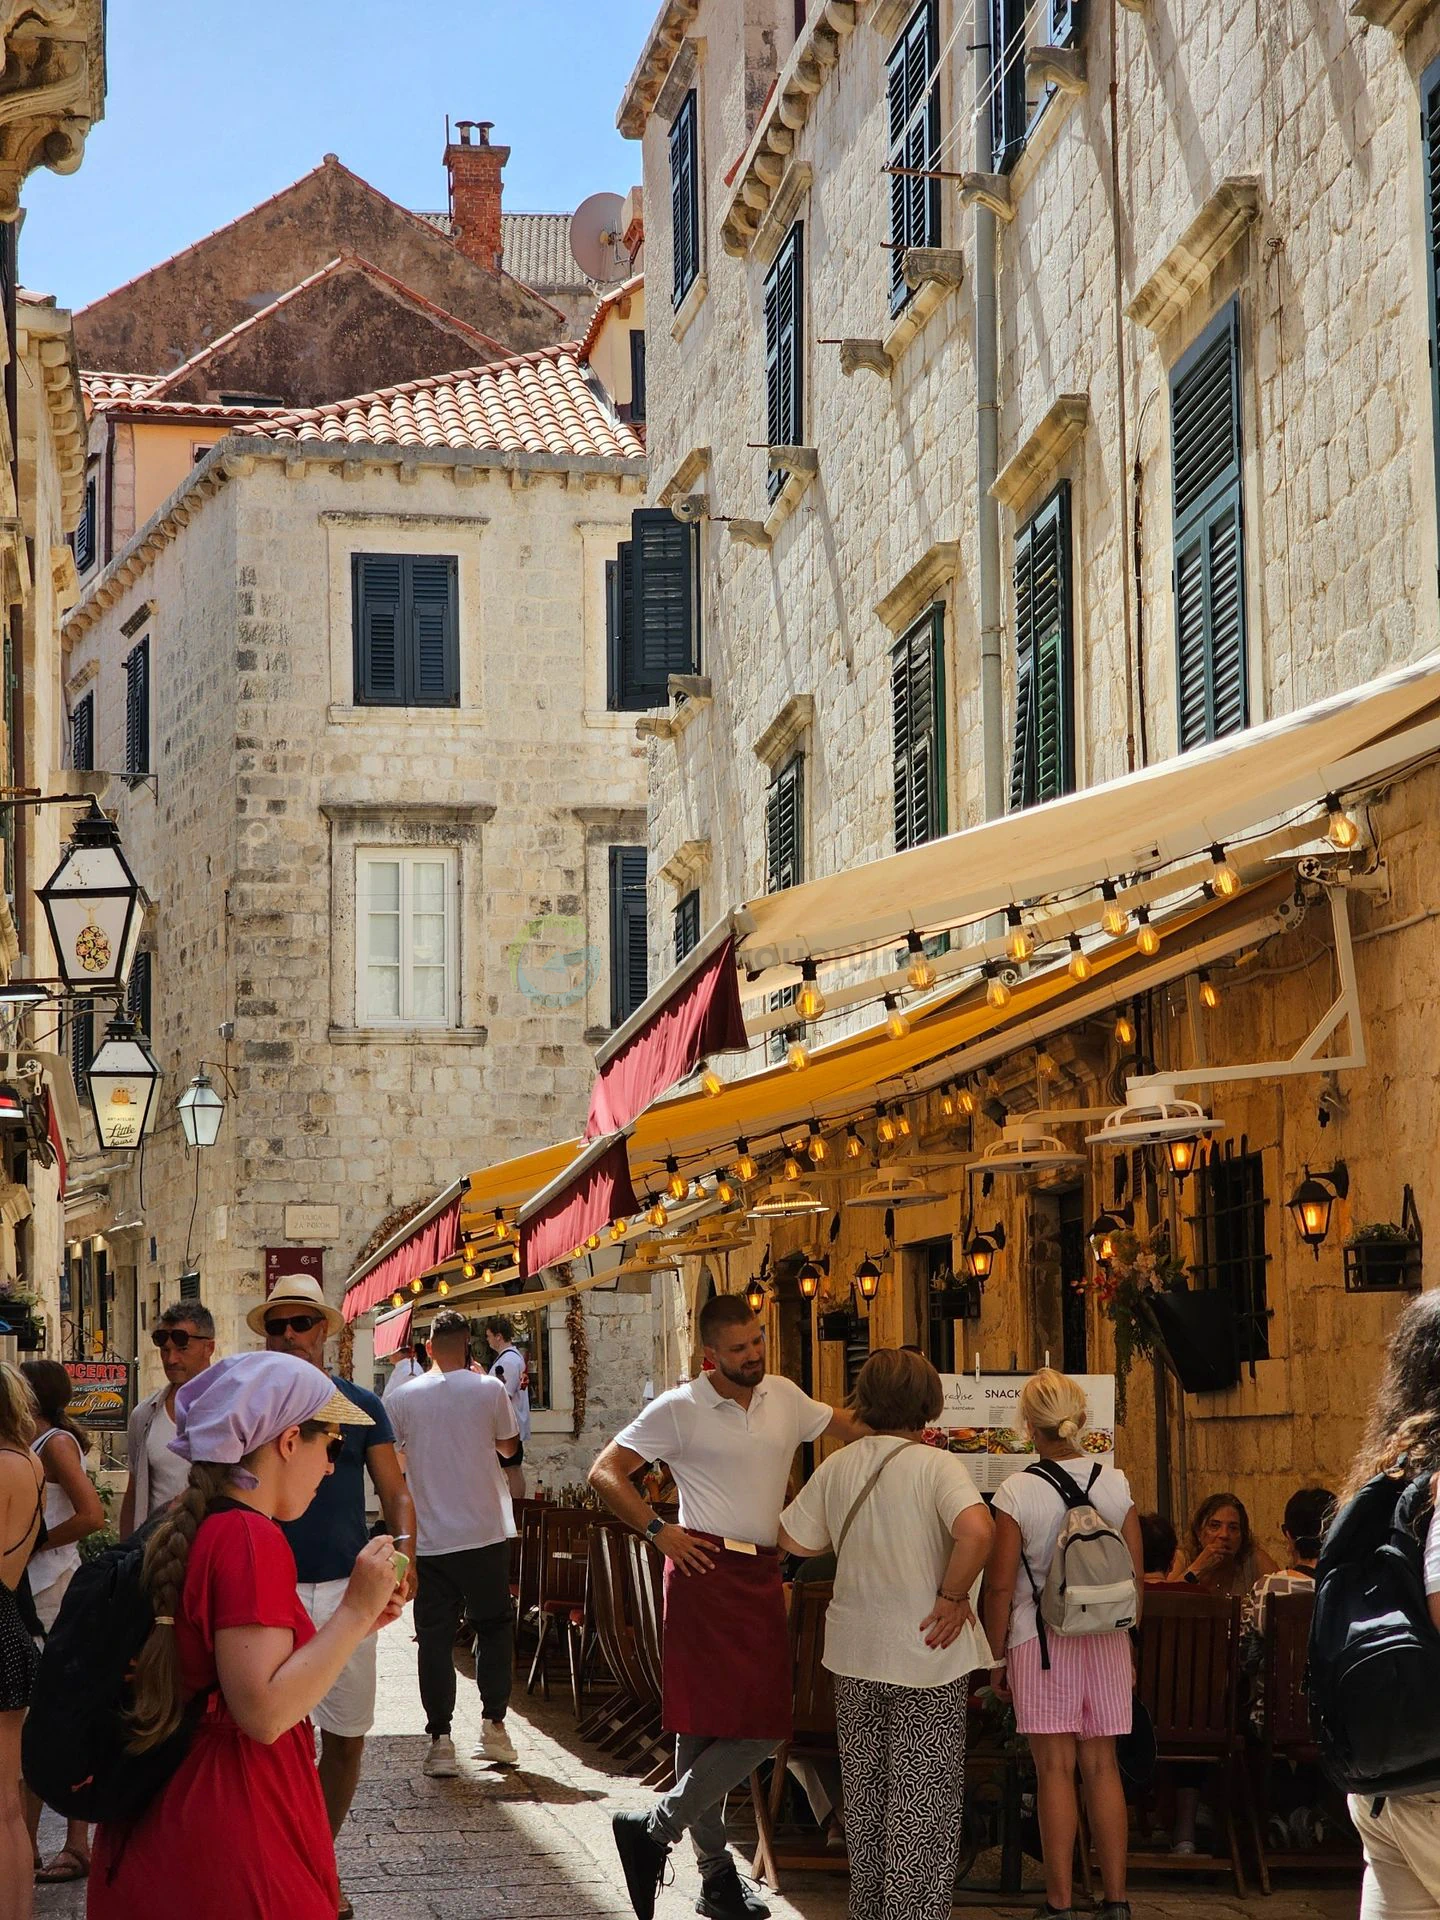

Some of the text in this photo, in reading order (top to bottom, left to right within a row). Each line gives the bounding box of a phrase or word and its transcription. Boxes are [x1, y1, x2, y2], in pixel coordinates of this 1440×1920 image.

[105, 1123, 136, 1138] Little
[64, 1363, 127, 1378] NCERTS
[985, 1389, 1021, 1398] SNACK
